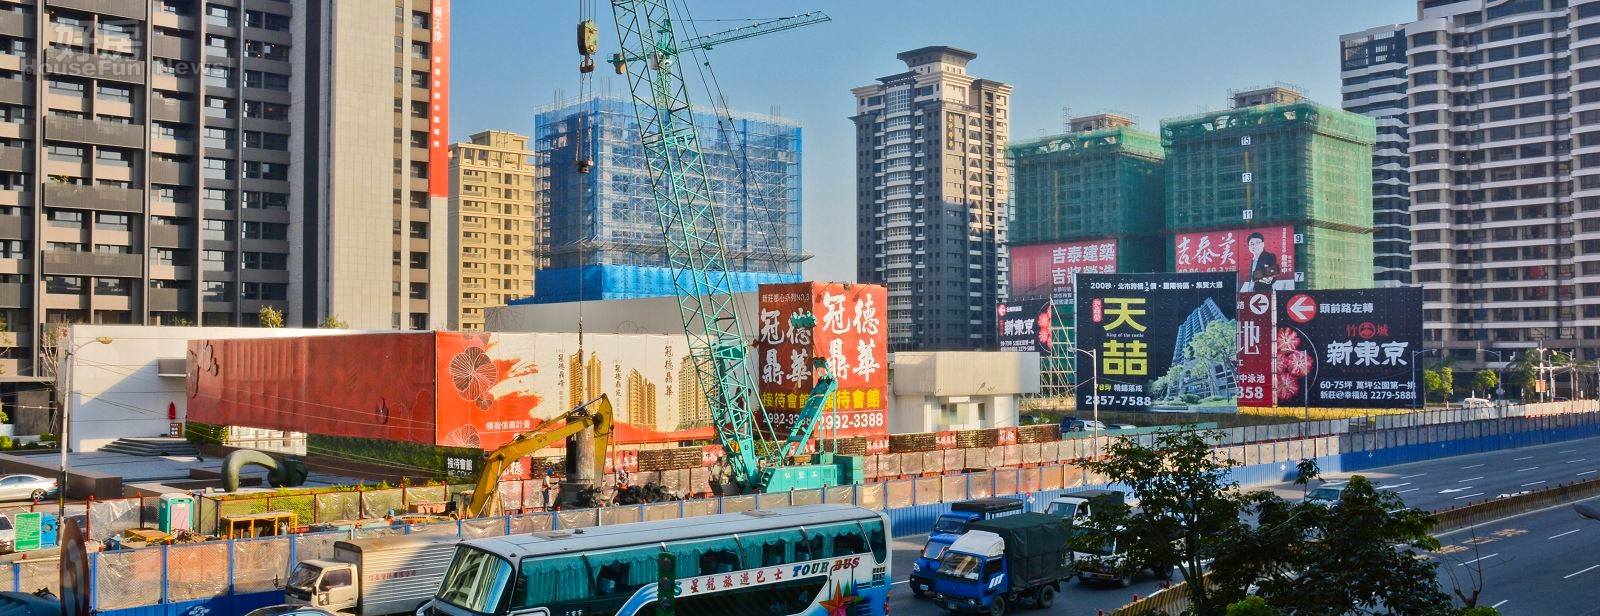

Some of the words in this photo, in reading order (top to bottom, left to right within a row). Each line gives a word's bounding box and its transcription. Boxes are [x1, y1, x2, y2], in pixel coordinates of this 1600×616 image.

[1053, 243, 1115, 264] 吉泰建築
[1177, 232, 1236, 265] 吉泰美
[823, 291, 880, 335] 冠德
[1320, 303, 1373, 314] 頭前路左轉
[1004, 318, 1035, 336] 新東京
[1326, 340, 1409, 366] 新東京
[1320, 381, 1352, 389] 60-75坪
[792, 561, 830, 577] TOUR
[832, 556, 861, 572] BUS
